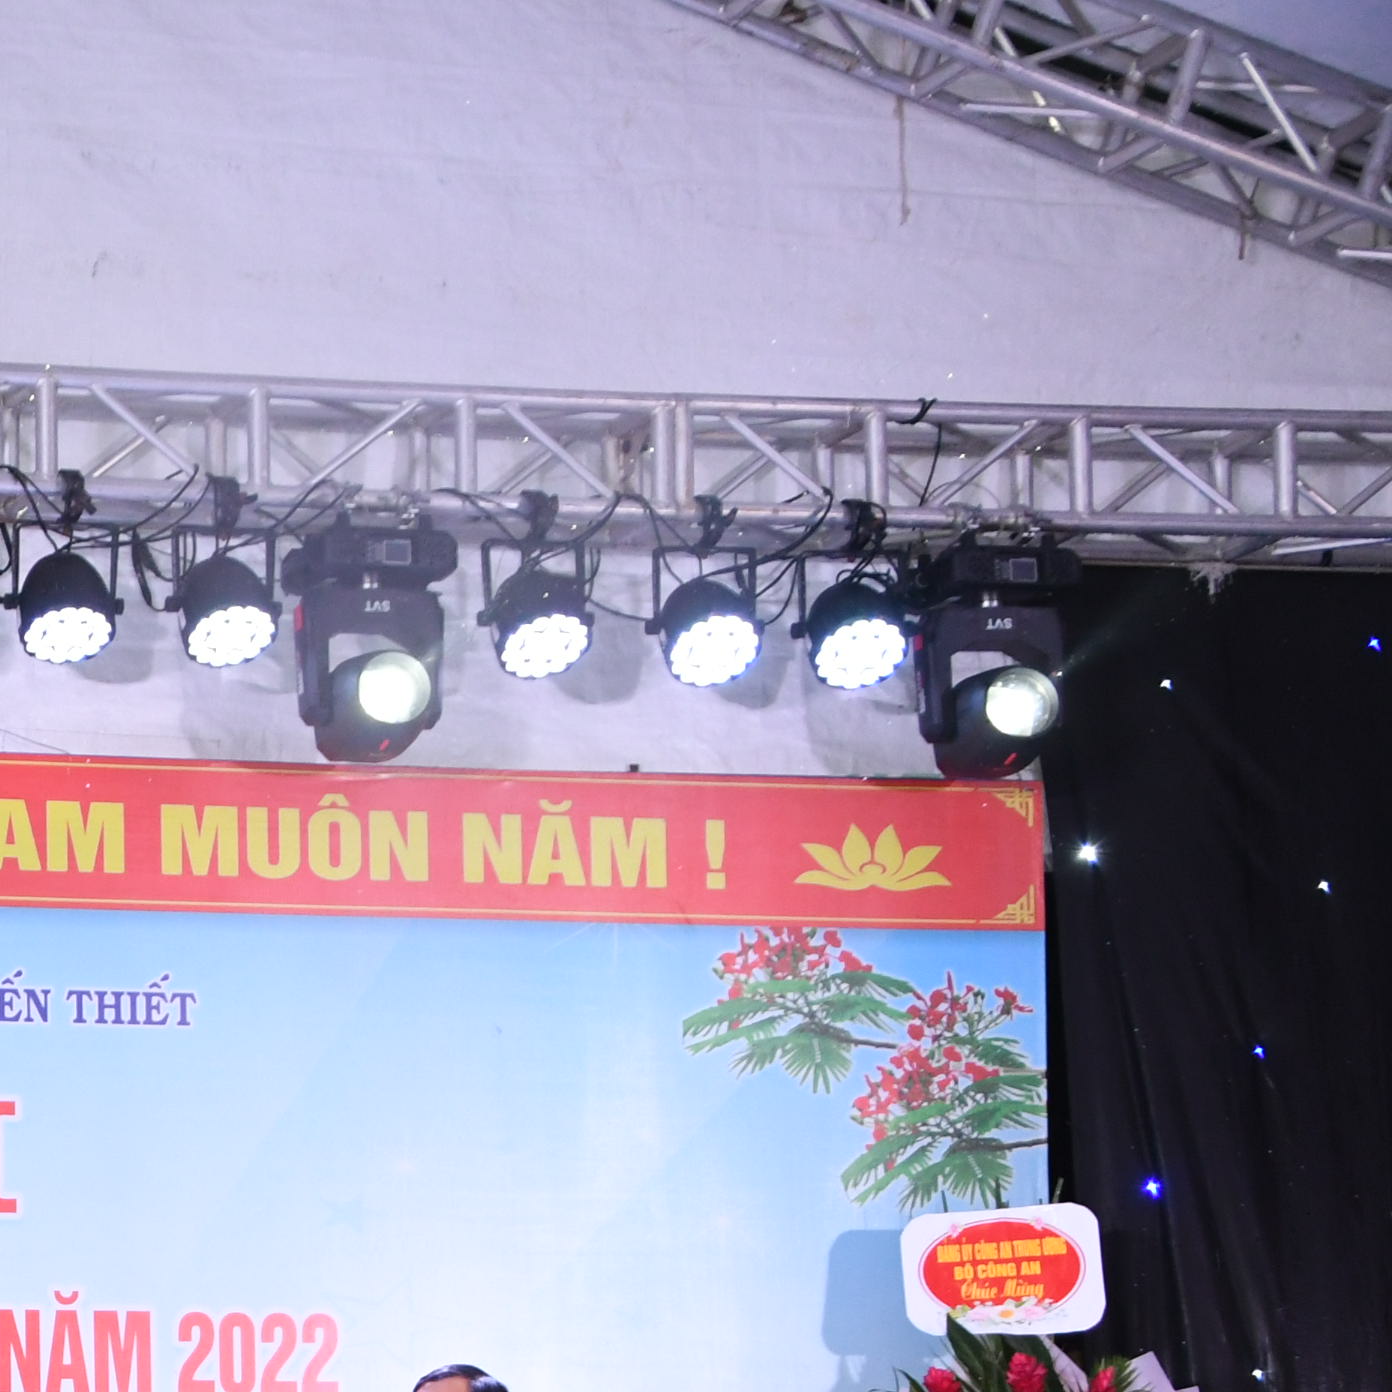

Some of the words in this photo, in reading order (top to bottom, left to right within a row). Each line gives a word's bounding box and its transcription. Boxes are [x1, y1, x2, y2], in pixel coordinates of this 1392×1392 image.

[364, 599, 391, 613] SVT
[985, 616, 1013, 631] SVT
[161, 794, 429, 881] MUÔN
[464, 801, 668, 889] NĂM
[707, 820, 726, 890] !
[67, 973, 196, 1026] THIẾT
[953, 1262, 975, 1281] BỘ
[977, 1260, 1018, 1279] CÔNG
[1020, 1261, 1042, 1276] AN
[960, 1279, 999, 1301] Chúc
